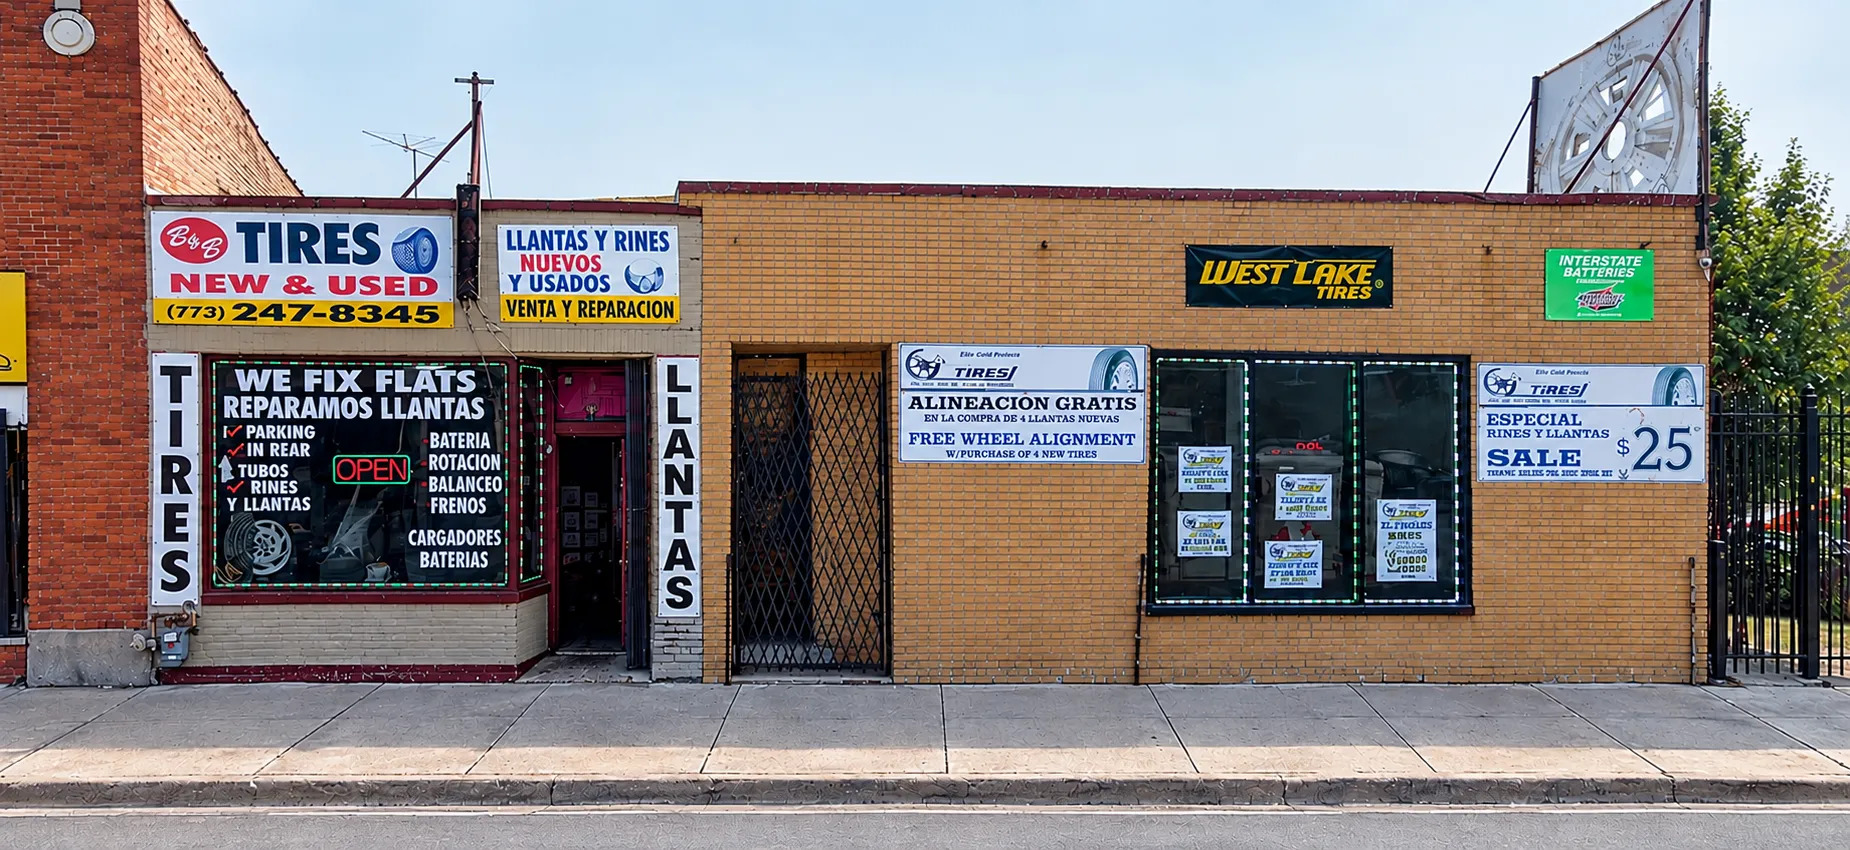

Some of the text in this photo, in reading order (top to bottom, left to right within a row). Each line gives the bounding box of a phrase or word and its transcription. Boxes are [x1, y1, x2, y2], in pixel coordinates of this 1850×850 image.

[236, 221, 381, 265] TIRES
[507, 229, 670, 252] LLANTAS Y RINES
[520, 254, 602, 273] NUEVOS
[1558, 255, 1643, 267] INTERSTATE
[1199, 260, 1377, 286] WEST LAKE
[1563, 267, 1636, 278] BATTERIES
[170, 273, 438, 297] NEW & USED
[508, 274, 611, 293] Y USADOS
[1316, 286, 1373, 300] TIRES
[167, 302, 441, 323] (773) 247-8345
[506, 299, 674, 319] VENTA Y REPARACION
[234, 369, 477, 394] WE FIX FLATS
[224, 395, 485, 421] REPARAMOS LLANTAS
[1055, 396, 1137, 411] GRATIS
[924, 414, 1120, 424] EN LA COMPRA DE 4 LLANTAS NUEVAS
[1486, 413, 1582, 426] ESPECIAL
[246, 425, 315, 440] PARKING
[430, 432, 491, 449] BATERIA
[908, 432, 1136, 446] FREE WHEEL ALIGNMENT
[1486, 429, 1609, 439] RINES Y LLANTAS
[247, 443, 311, 457] IN REAR
[946, 450, 1097, 459] W/PURCHASE OF 4 NEW TIRES
[1487, 448, 1581, 467] SALE
[238, 464, 289, 478] TUBOS
[335, 457, 407, 481] OPEN
[428, 454, 501, 471] ROTACION
[160, 366, 193, 592] TIRES
[251, 480, 298, 494] RINES
[428, 476, 502, 493] BALANCEO
[663, 364, 696, 609] LLANTAS
[227, 496, 311, 512] Y LLANTAS
[430, 497, 487, 514] FRENOS
[408, 529, 502, 547] CARGADORES
[419, 552, 488, 568] BATERIAS
